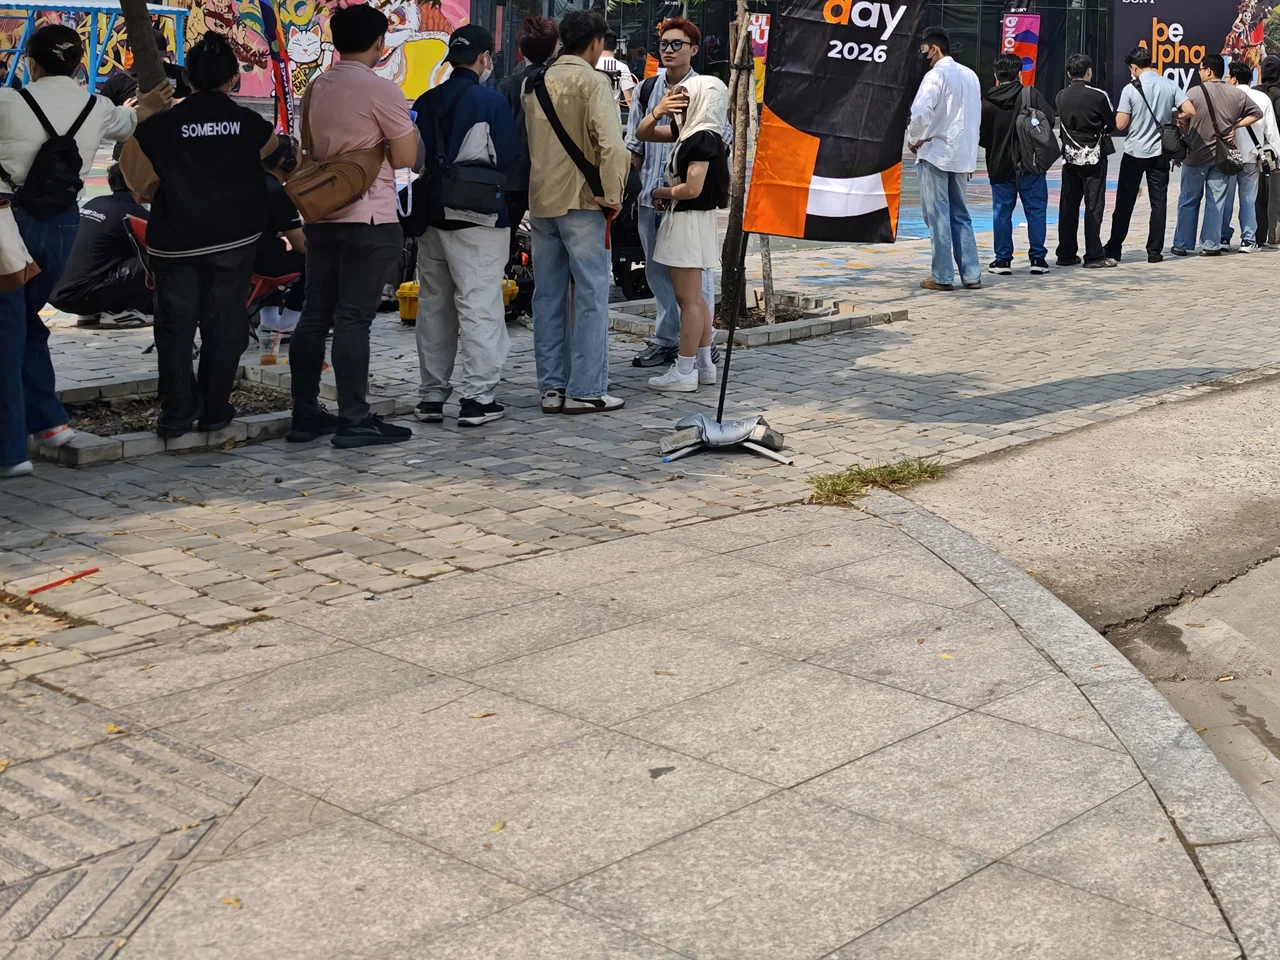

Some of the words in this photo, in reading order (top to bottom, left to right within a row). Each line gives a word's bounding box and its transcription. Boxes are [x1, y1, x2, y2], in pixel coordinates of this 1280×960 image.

[1152, 17, 1184, 43] be
[827, 40, 888, 63] 2026
[181, 121, 242, 138] SOMEHOW
